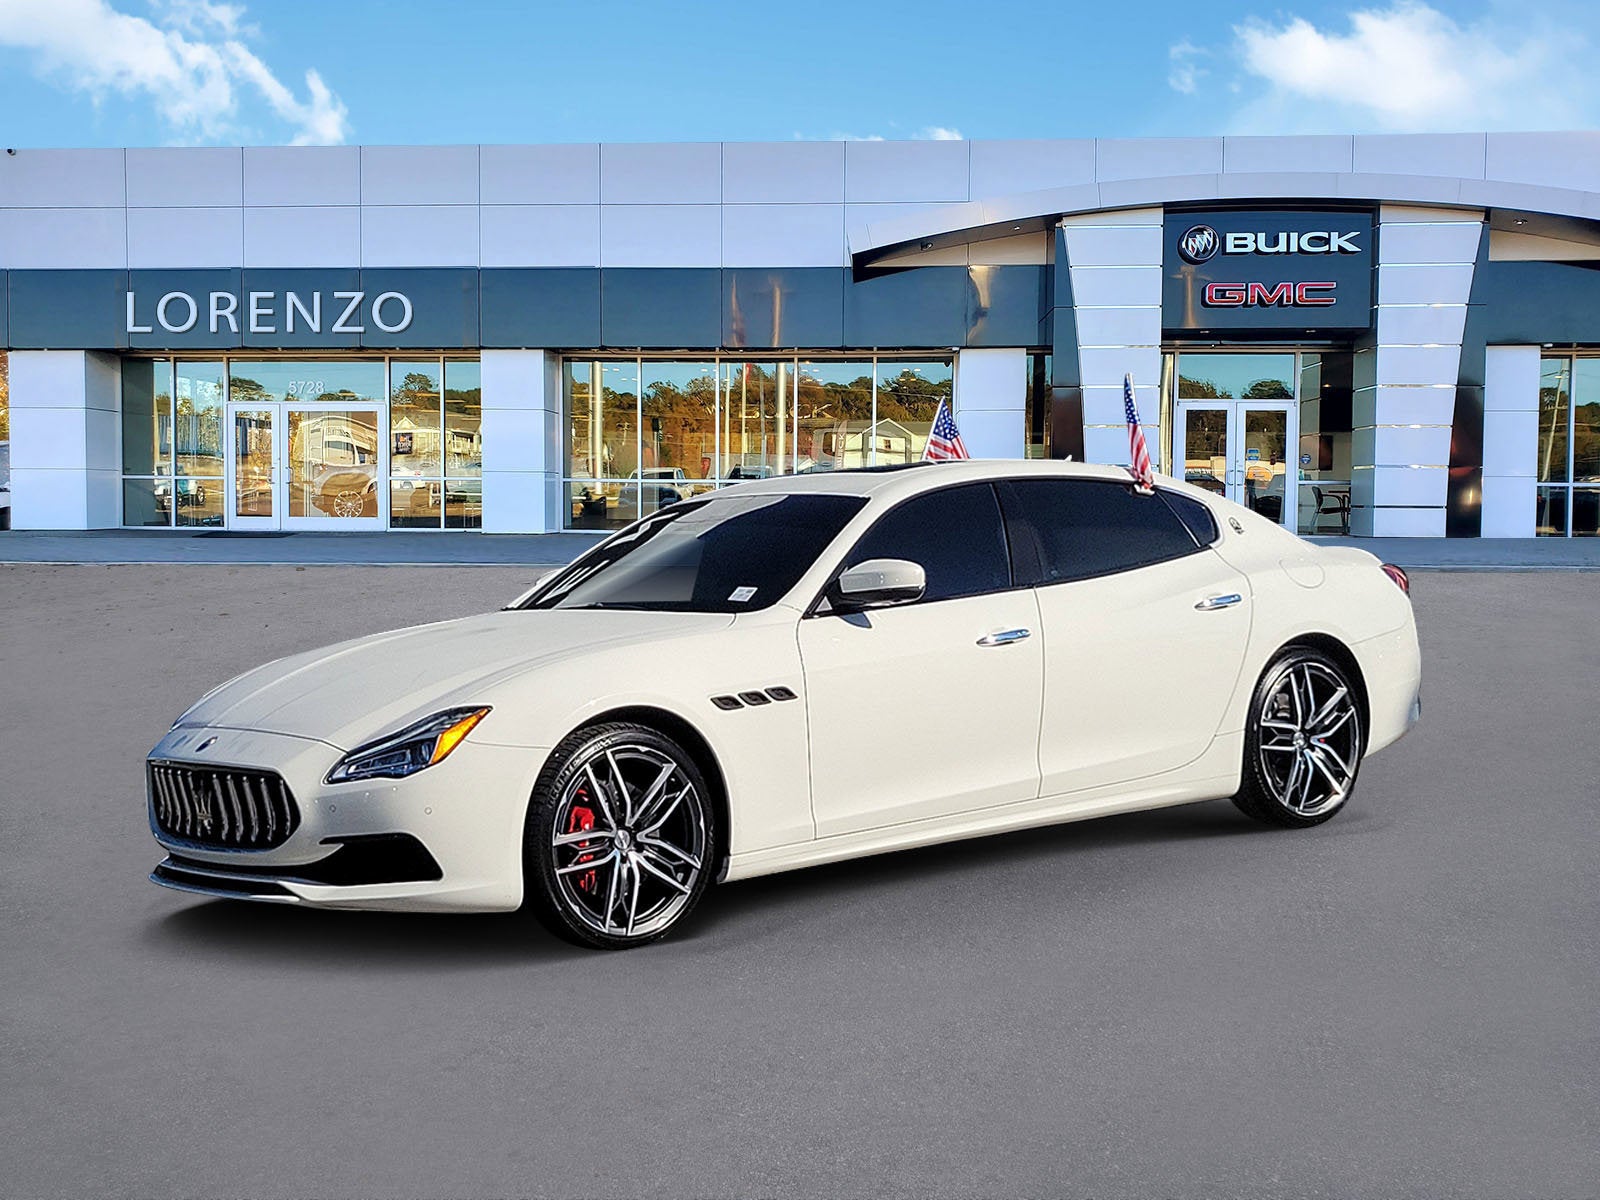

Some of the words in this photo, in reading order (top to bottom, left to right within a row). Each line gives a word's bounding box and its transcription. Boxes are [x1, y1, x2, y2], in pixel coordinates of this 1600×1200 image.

[1225, 231, 1362, 253] BUICK
[1205, 281, 1337, 306] GMC
[126, 291, 413, 333] LORENZO
[288, 381, 326, 395] 5728
